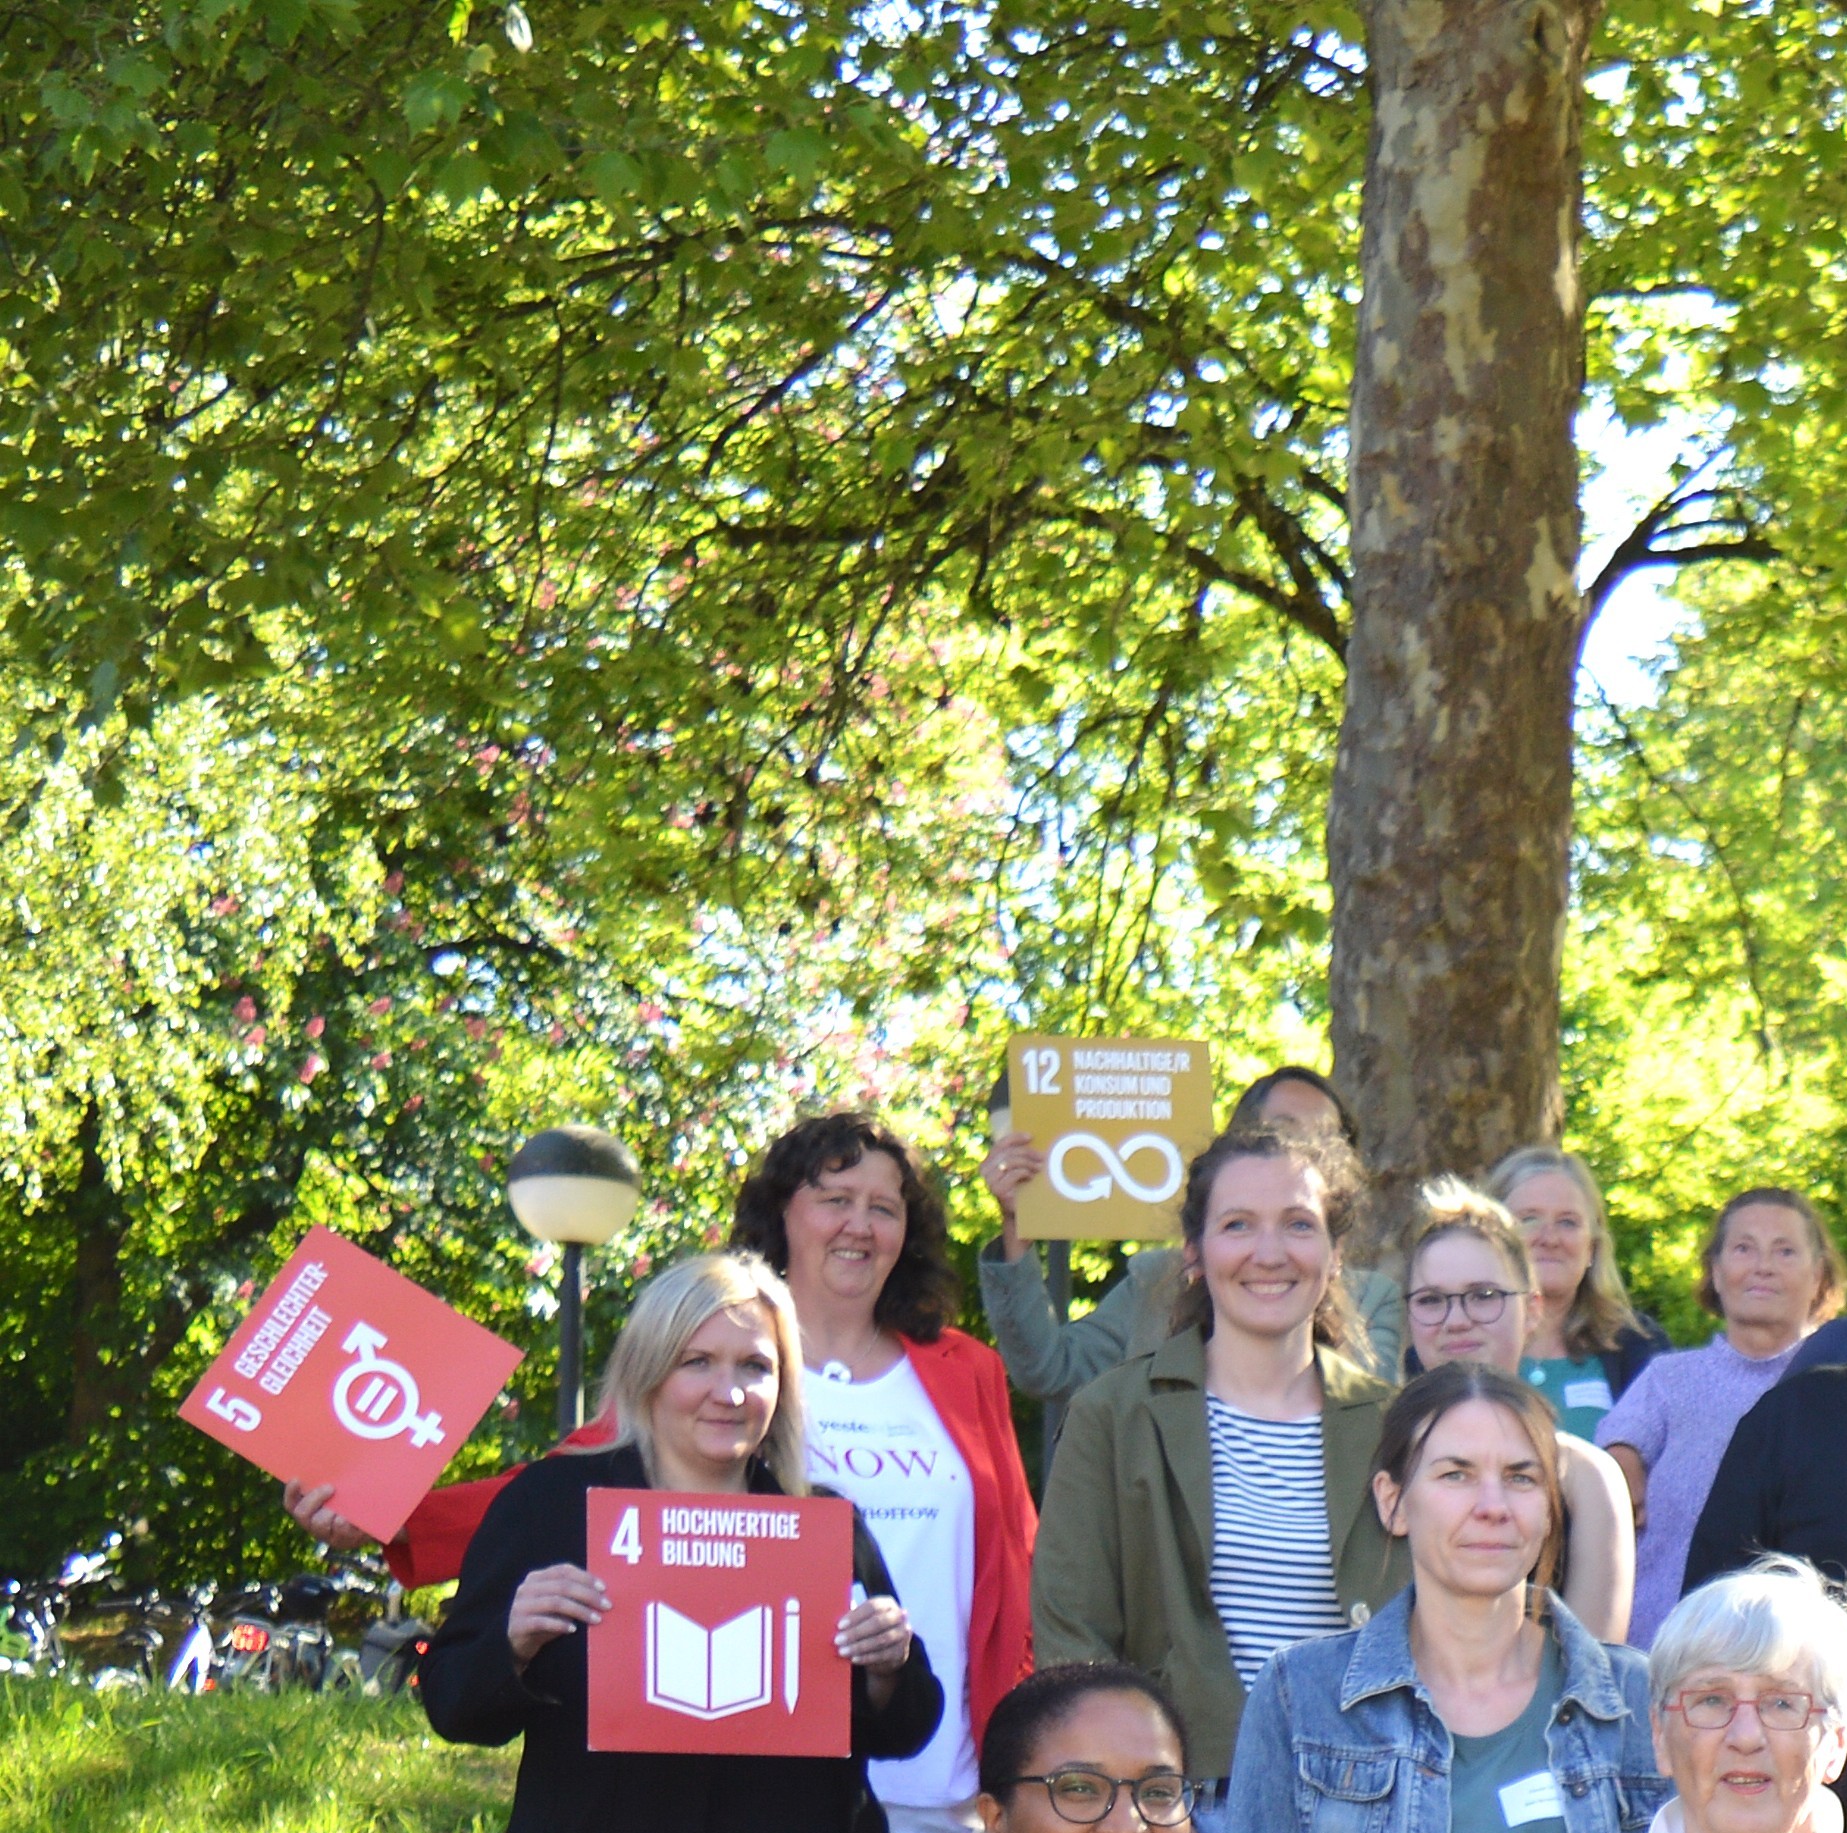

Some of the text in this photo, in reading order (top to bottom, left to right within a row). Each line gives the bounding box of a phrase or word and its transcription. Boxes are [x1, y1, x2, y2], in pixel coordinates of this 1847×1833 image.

[1022, 1049, 1191, 1094] 12 NACHHALTIGE/R
[1074, 1074, 1172, 1096] KONSUM UND
[1075, 1098, 1172, 1120] PRODUKTION
[205, 1261, 329, 1432] 5 GESCHLECHTER-
[259, 1304, 333, 1395] GLEICHHEIT
[610, 1507, 800, 1564] 4 HOCHWERTIGE
[662, 1540, 746, 1568] BILDUNG
